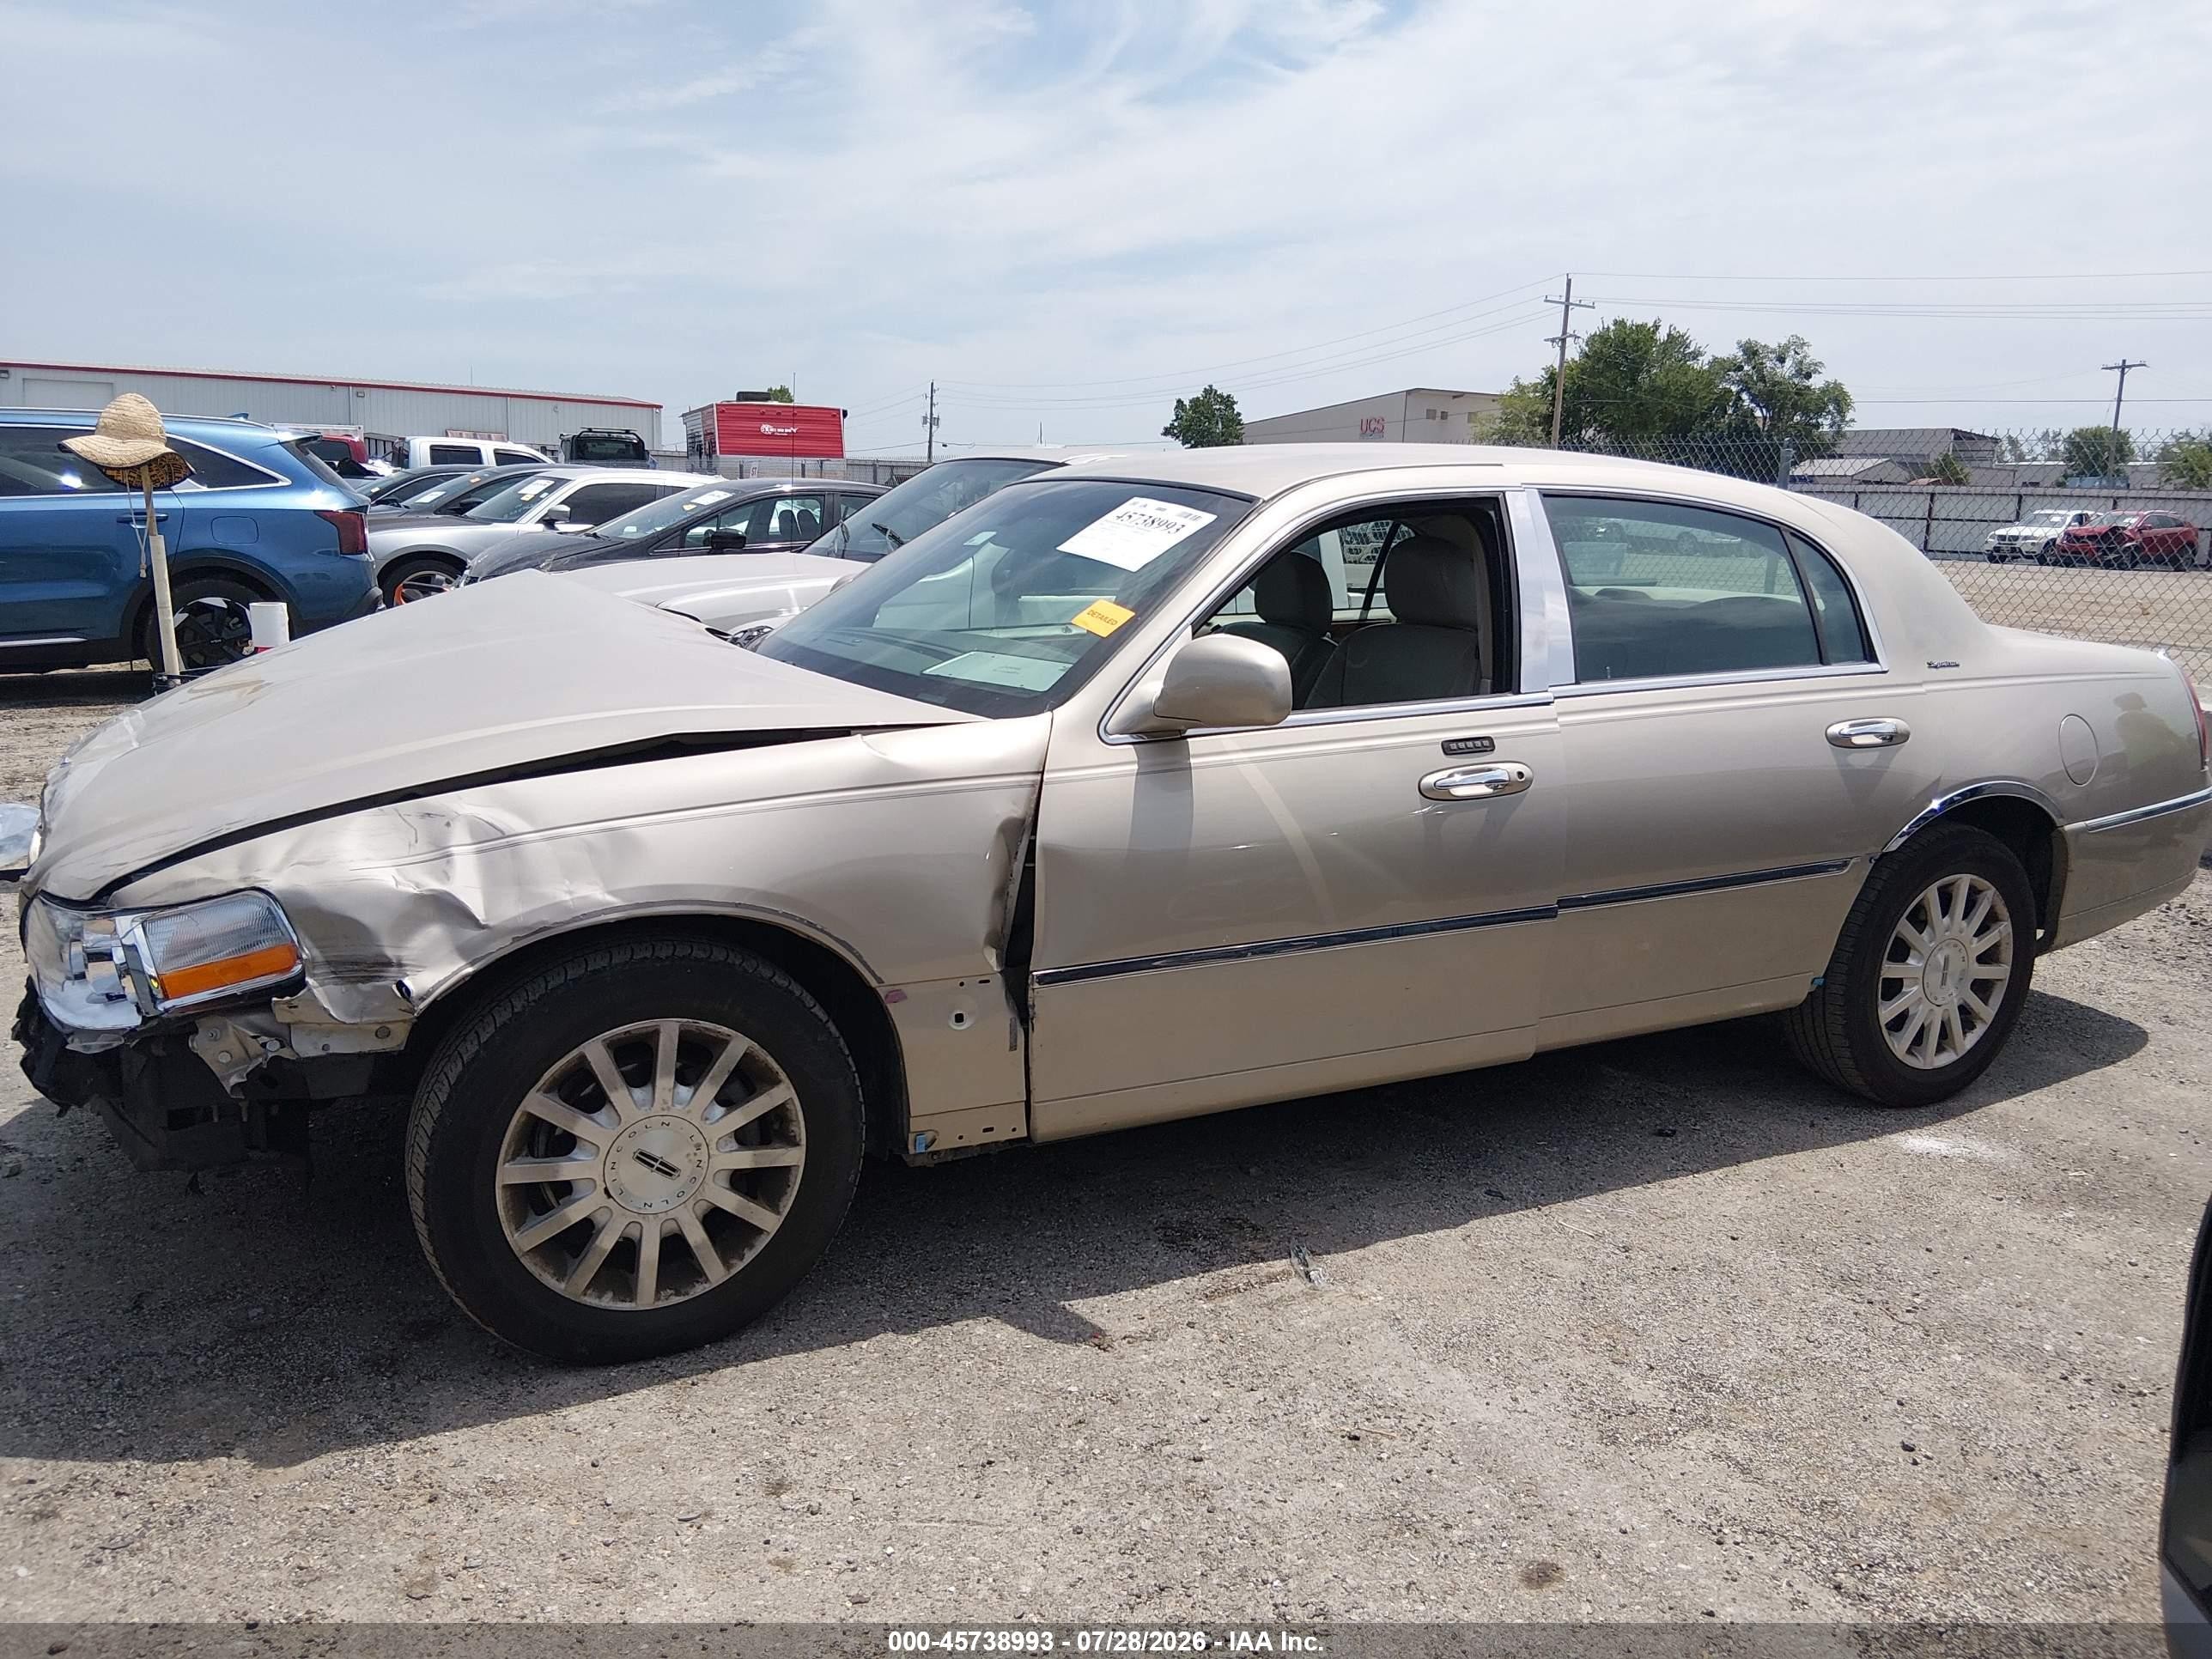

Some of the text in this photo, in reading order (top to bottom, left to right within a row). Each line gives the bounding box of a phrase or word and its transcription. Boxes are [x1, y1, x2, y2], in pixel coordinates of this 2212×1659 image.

[1360, 416, 1384, 434] UCS
[1115, 510, 1186, 535] 45738993
[1087, 609, 1118, 625] DETAILED
[611, 1121, 671, 1196] LINCOLN
[644, 1134, 702, 1208] LINCOLN
